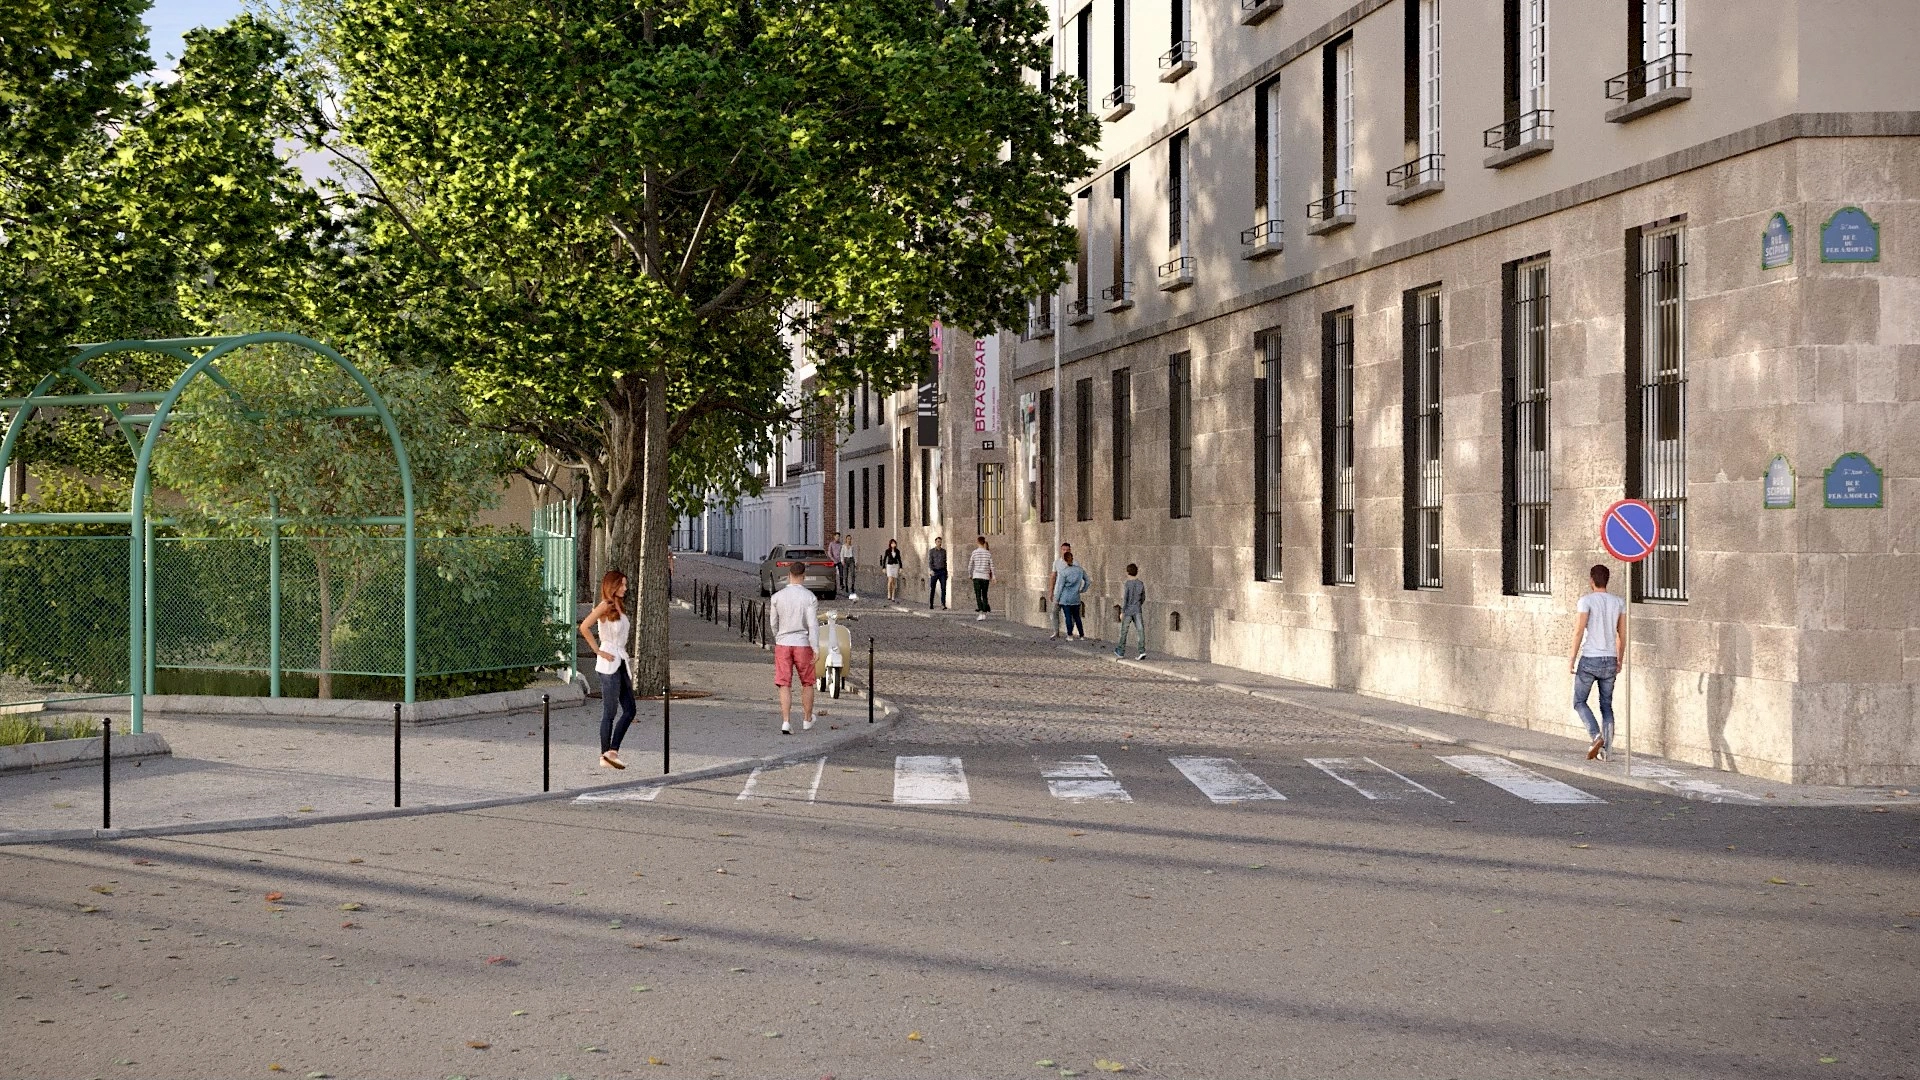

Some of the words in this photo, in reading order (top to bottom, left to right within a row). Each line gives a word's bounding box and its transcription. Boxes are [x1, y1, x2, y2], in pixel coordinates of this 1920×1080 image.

[1770, 235, 1782, 246] RUE
[1765, 243, 1789, 257] SCIPION
[975, 340, 986, 432] BRASSAR
